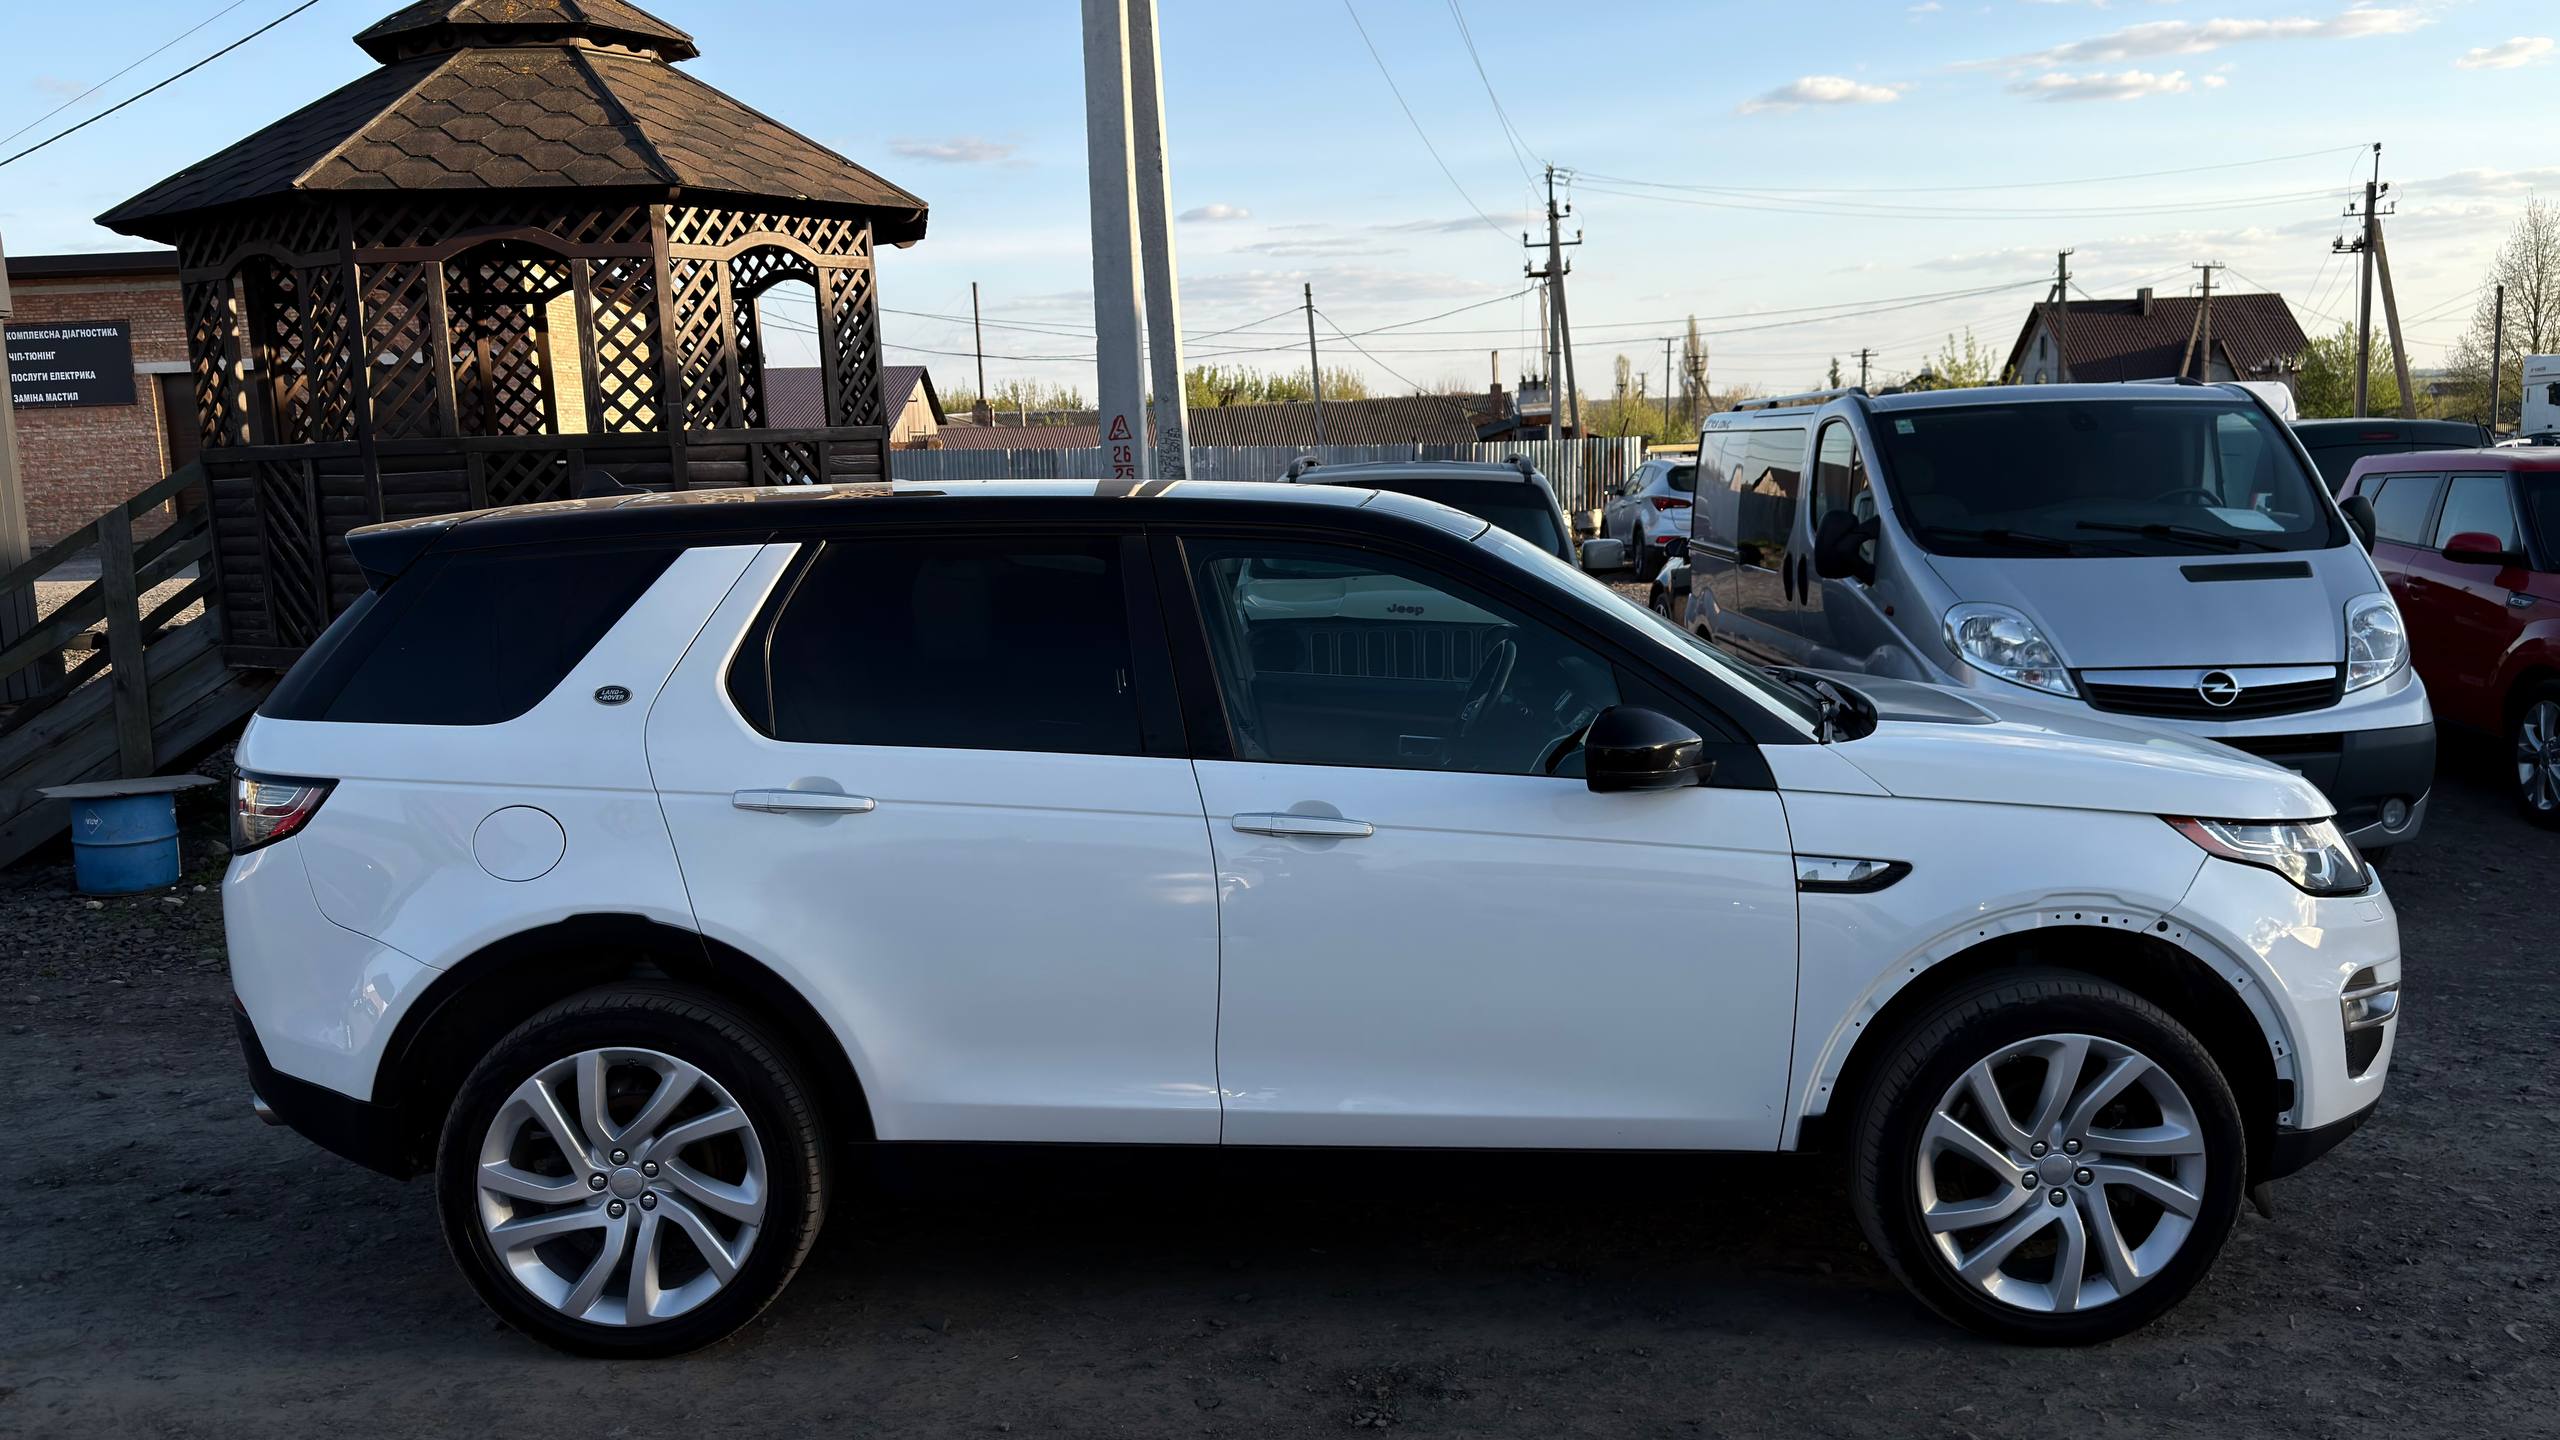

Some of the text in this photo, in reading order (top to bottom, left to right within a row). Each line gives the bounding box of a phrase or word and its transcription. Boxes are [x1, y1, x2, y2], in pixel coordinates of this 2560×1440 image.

[5, 327, 118, 341] КОМПЛЕКСНА ДІАГНОСТИКА
[8, 351, 56, 361] ЧІП-ТЮНІНГ
[11, 370, 96, 382] ПОСЛУГИ ЕЛЕКТРИКА
[13, 391, 79, 403] ЗАМІНА МАСТИЛ
[1113, 445, 1132, 463] 26
[1115, 468, 1135, 479] 25
[1386, 603, 1424, 616] Jeep
